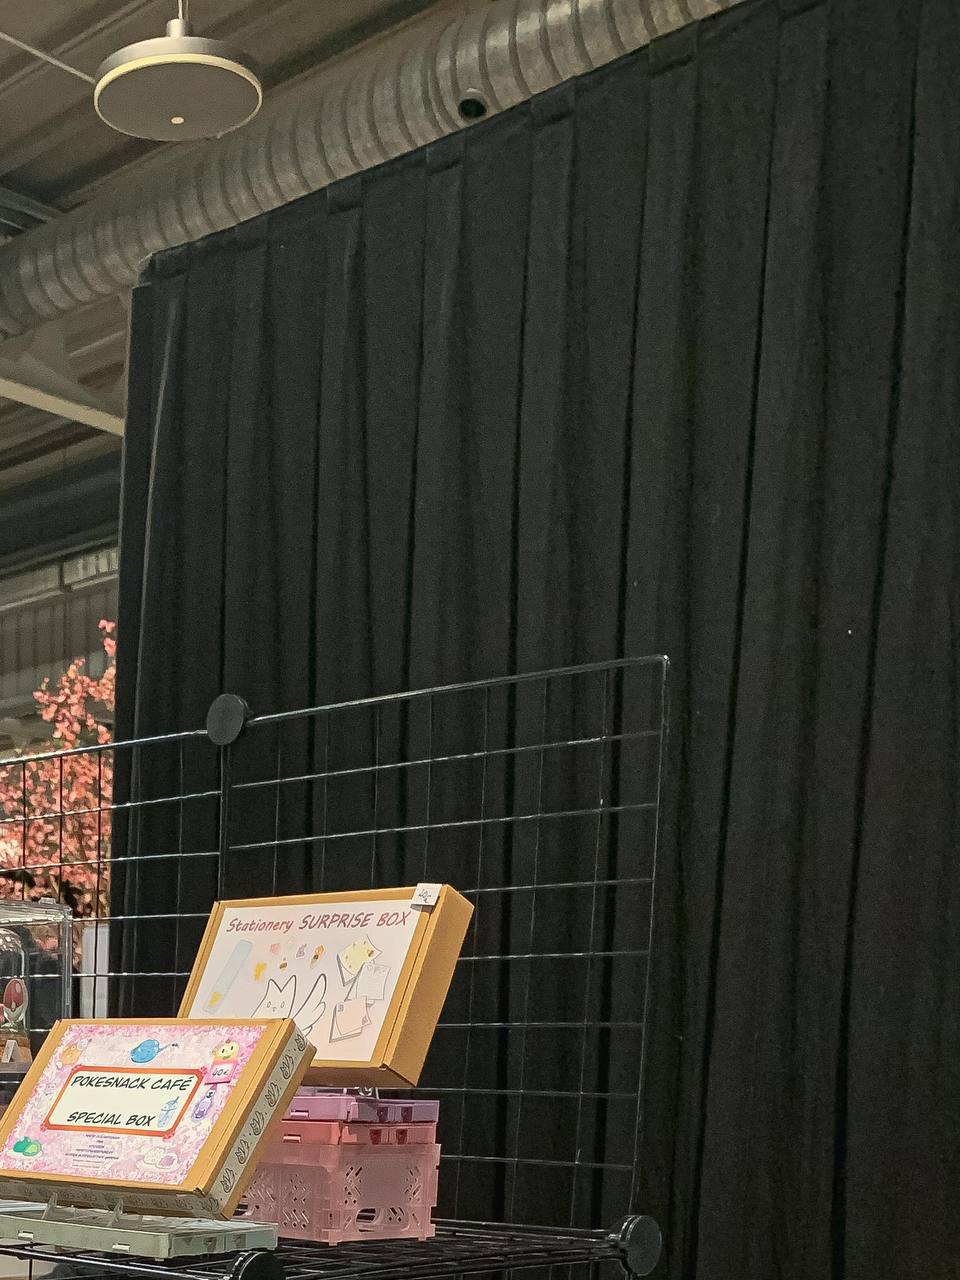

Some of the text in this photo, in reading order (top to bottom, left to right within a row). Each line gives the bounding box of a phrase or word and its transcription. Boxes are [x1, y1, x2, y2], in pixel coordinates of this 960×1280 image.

[226, 910, 412, 934] Stationery SURPRISE BOX
[70, 1075, 195, 1091] POKESNACK CAFÉ
[67, 1111, 156, 1127] SPECIAL BOX
